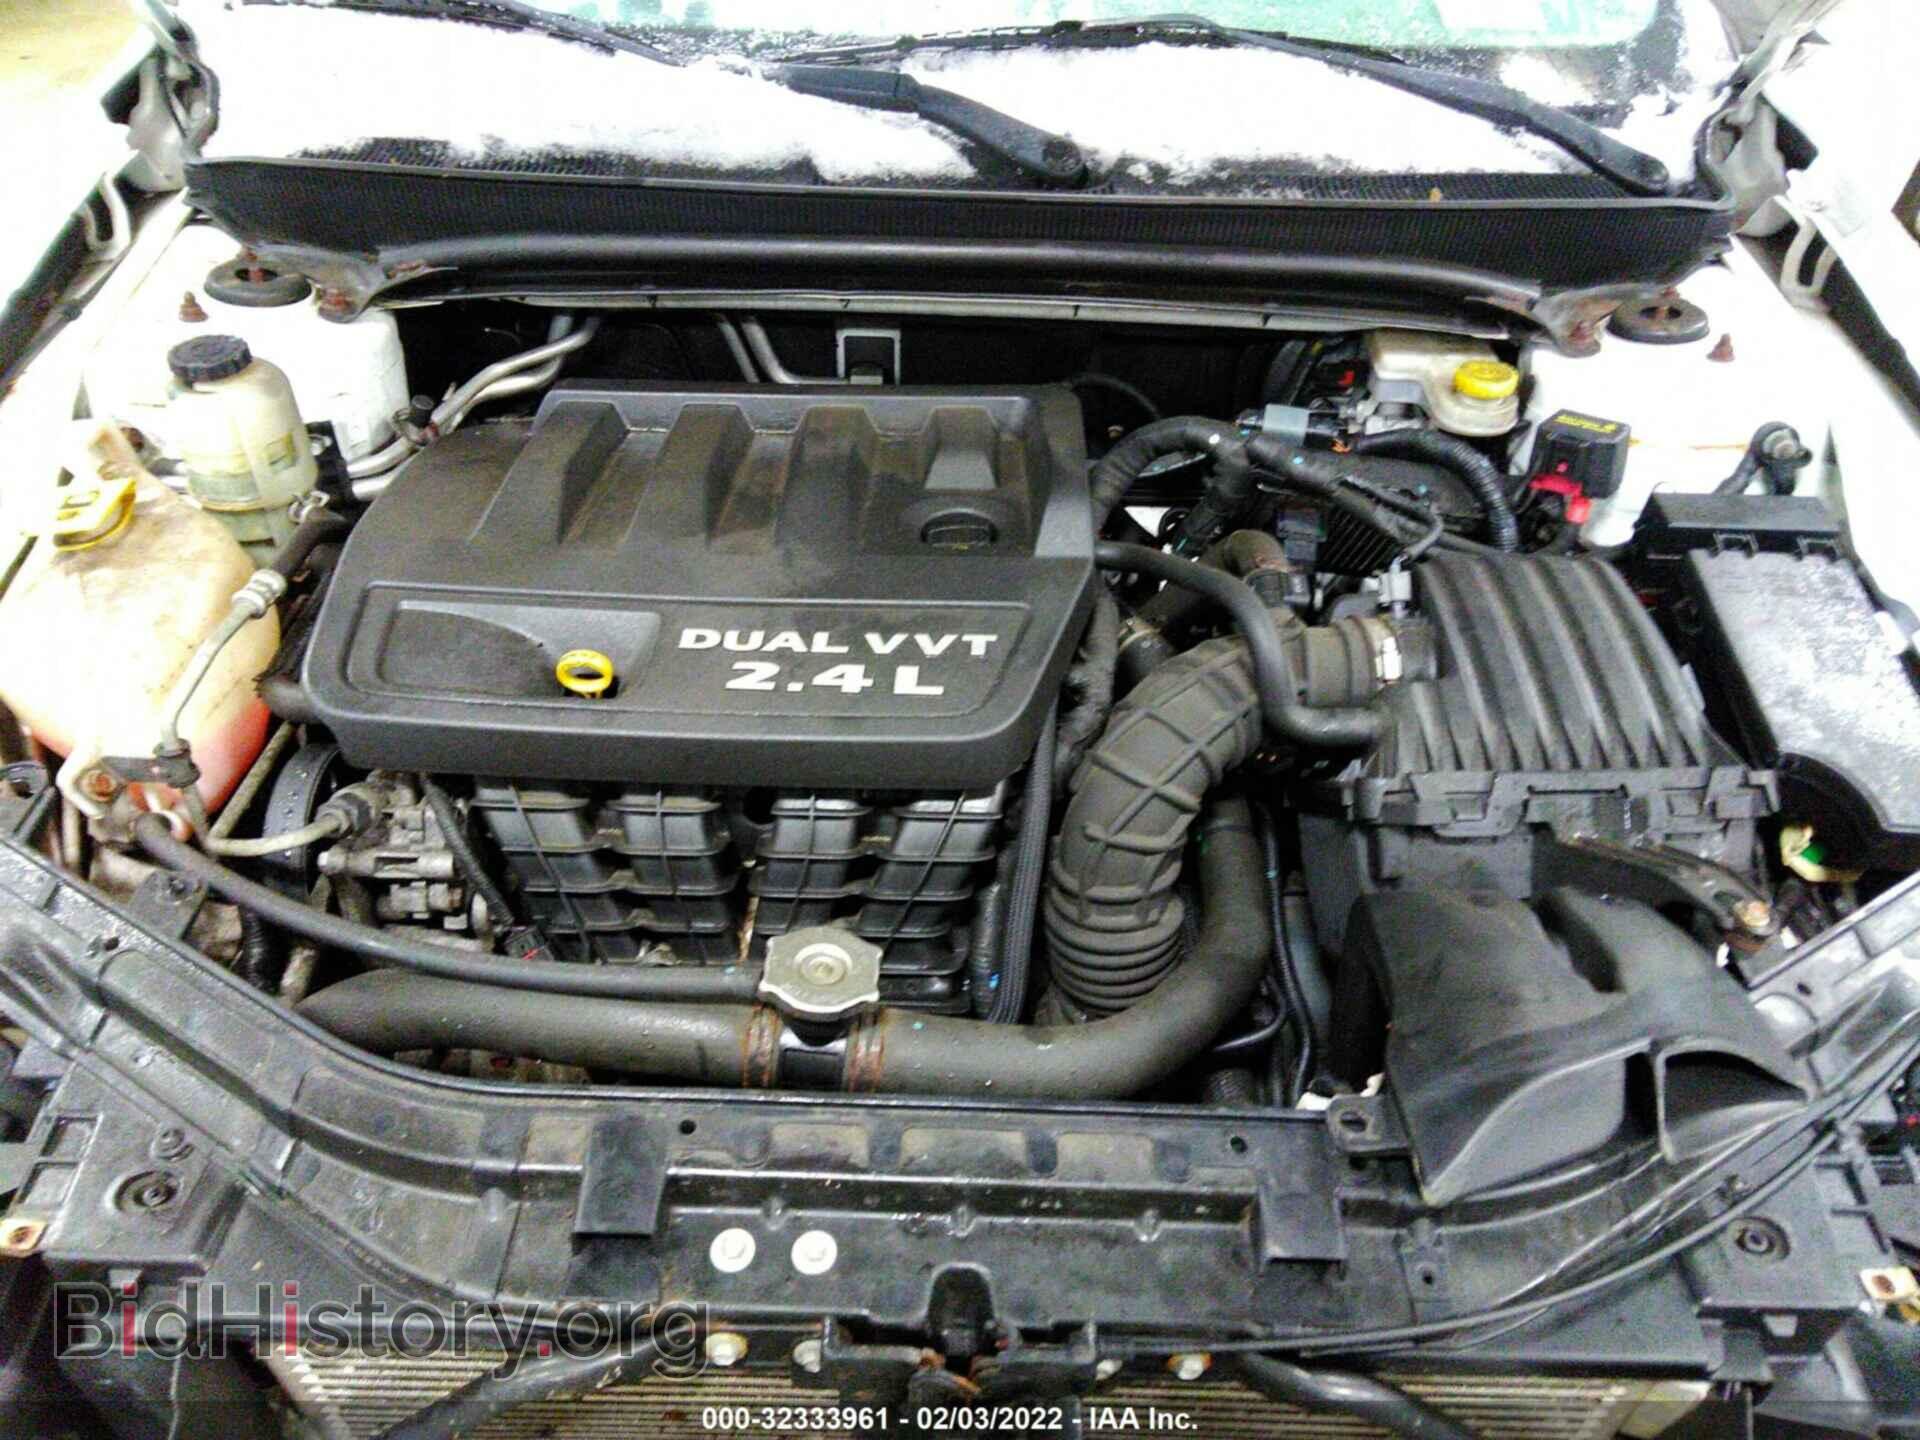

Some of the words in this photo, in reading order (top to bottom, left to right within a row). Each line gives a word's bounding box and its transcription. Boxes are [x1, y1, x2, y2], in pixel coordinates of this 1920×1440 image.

[678, 628, 850, 654] DUAL
[863, 632, 998, 657] VVT
[724, 661, 874, 693] 2.4
[893, 665, 944, 696] L
